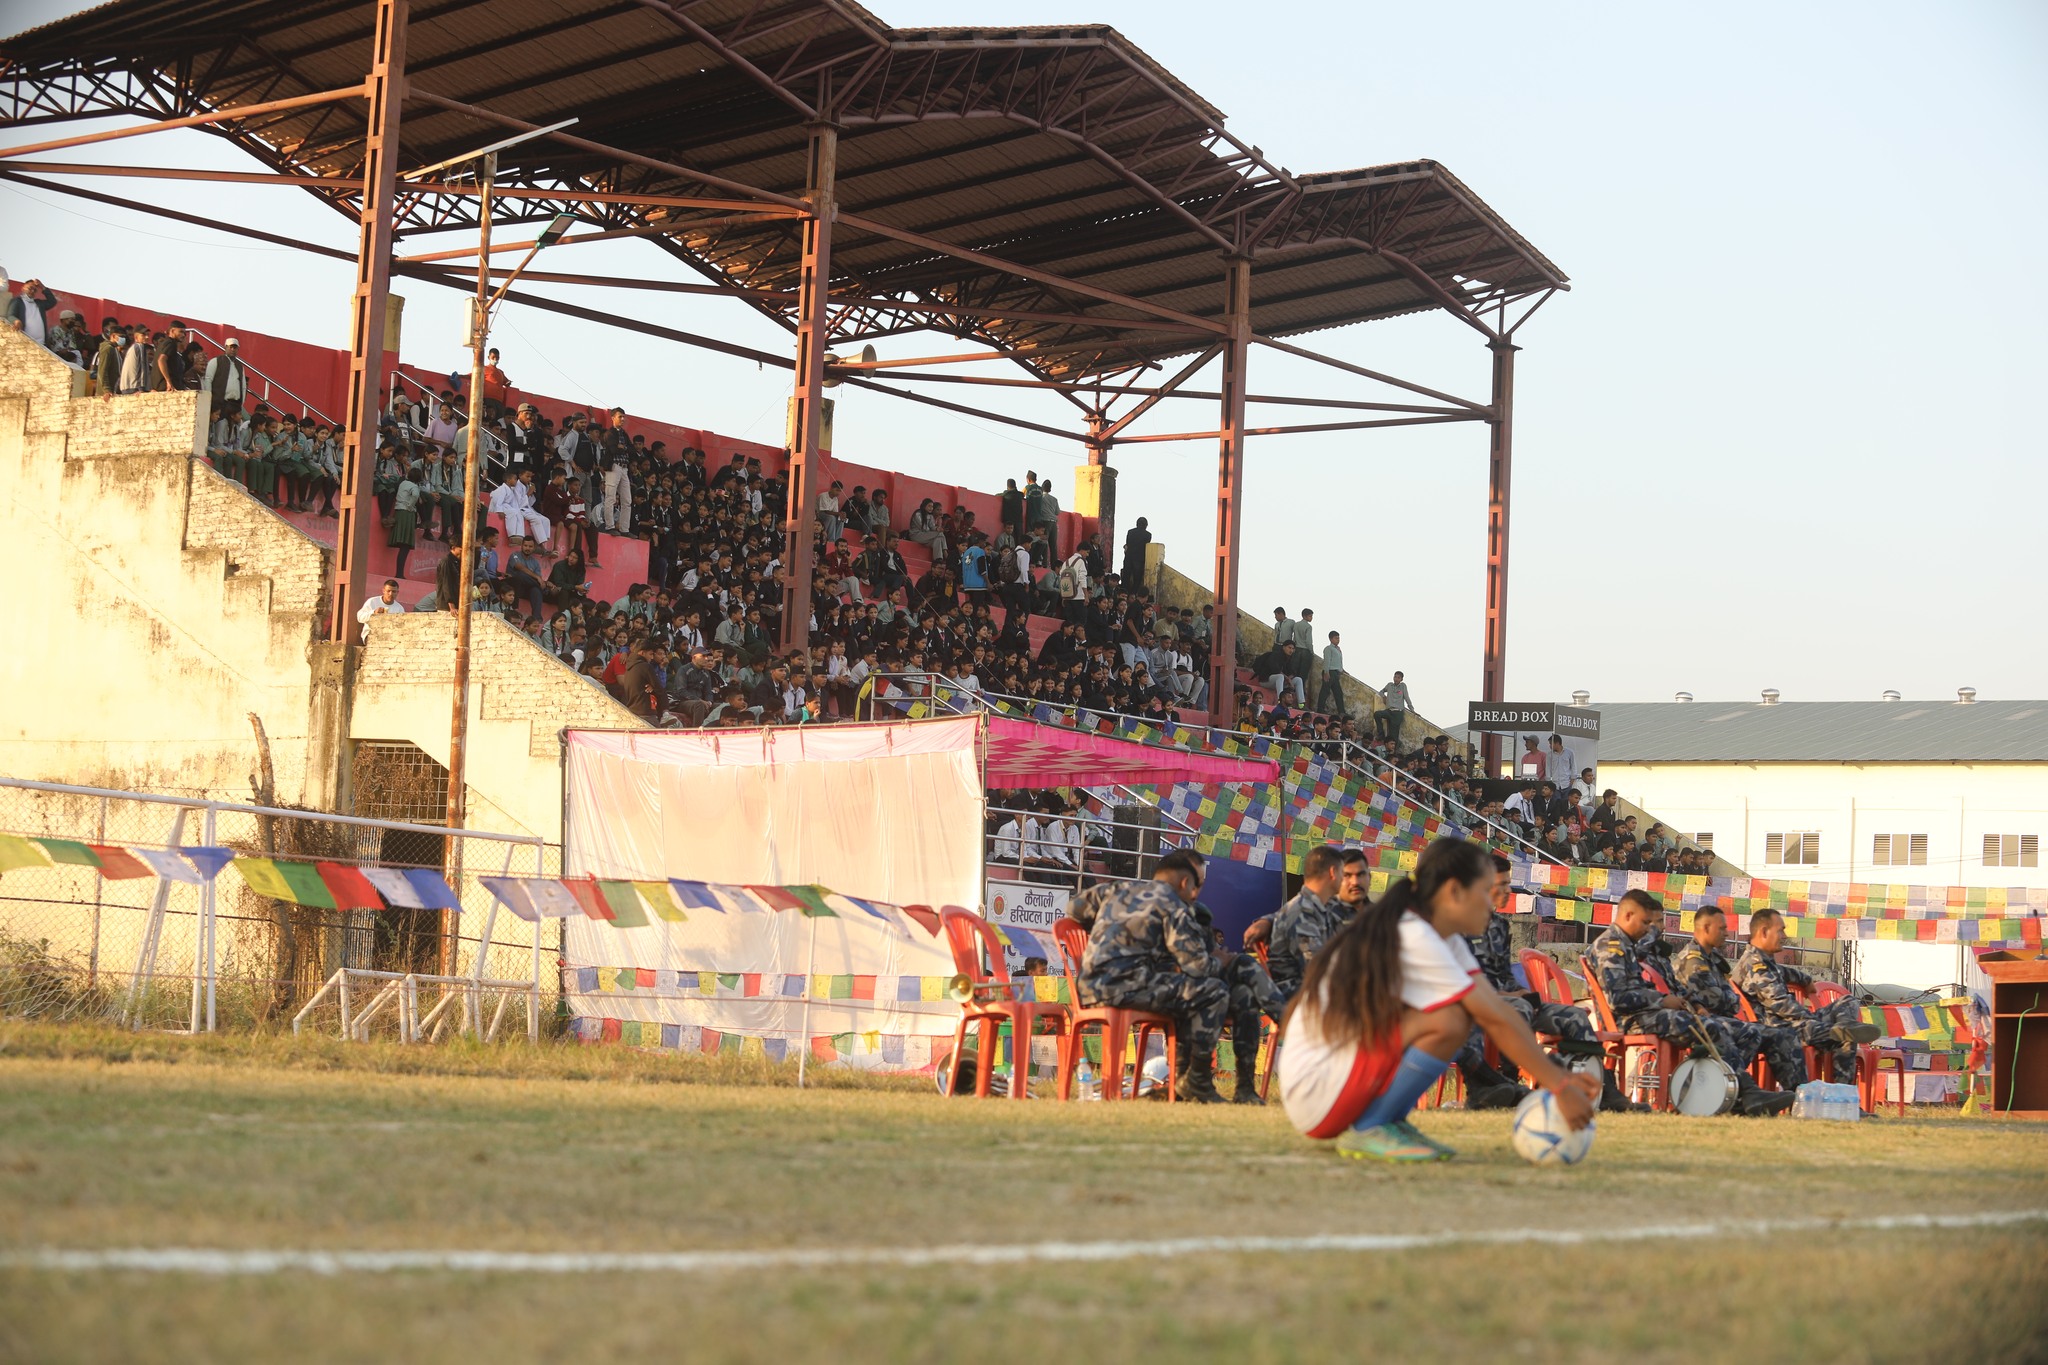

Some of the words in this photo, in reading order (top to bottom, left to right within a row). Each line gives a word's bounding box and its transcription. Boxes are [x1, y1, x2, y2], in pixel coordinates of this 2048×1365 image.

[1473, 710, 1518, 722] BREAD
[1521, 711, 1549, 723] BOX
[1557, 714, 1581, 728] BREAD
[1583, 718, 1598, 731] BOX
[1024, 889, 1054, 908] कैलाली
[1010, 905, 1042, 924] हस्पिटल
